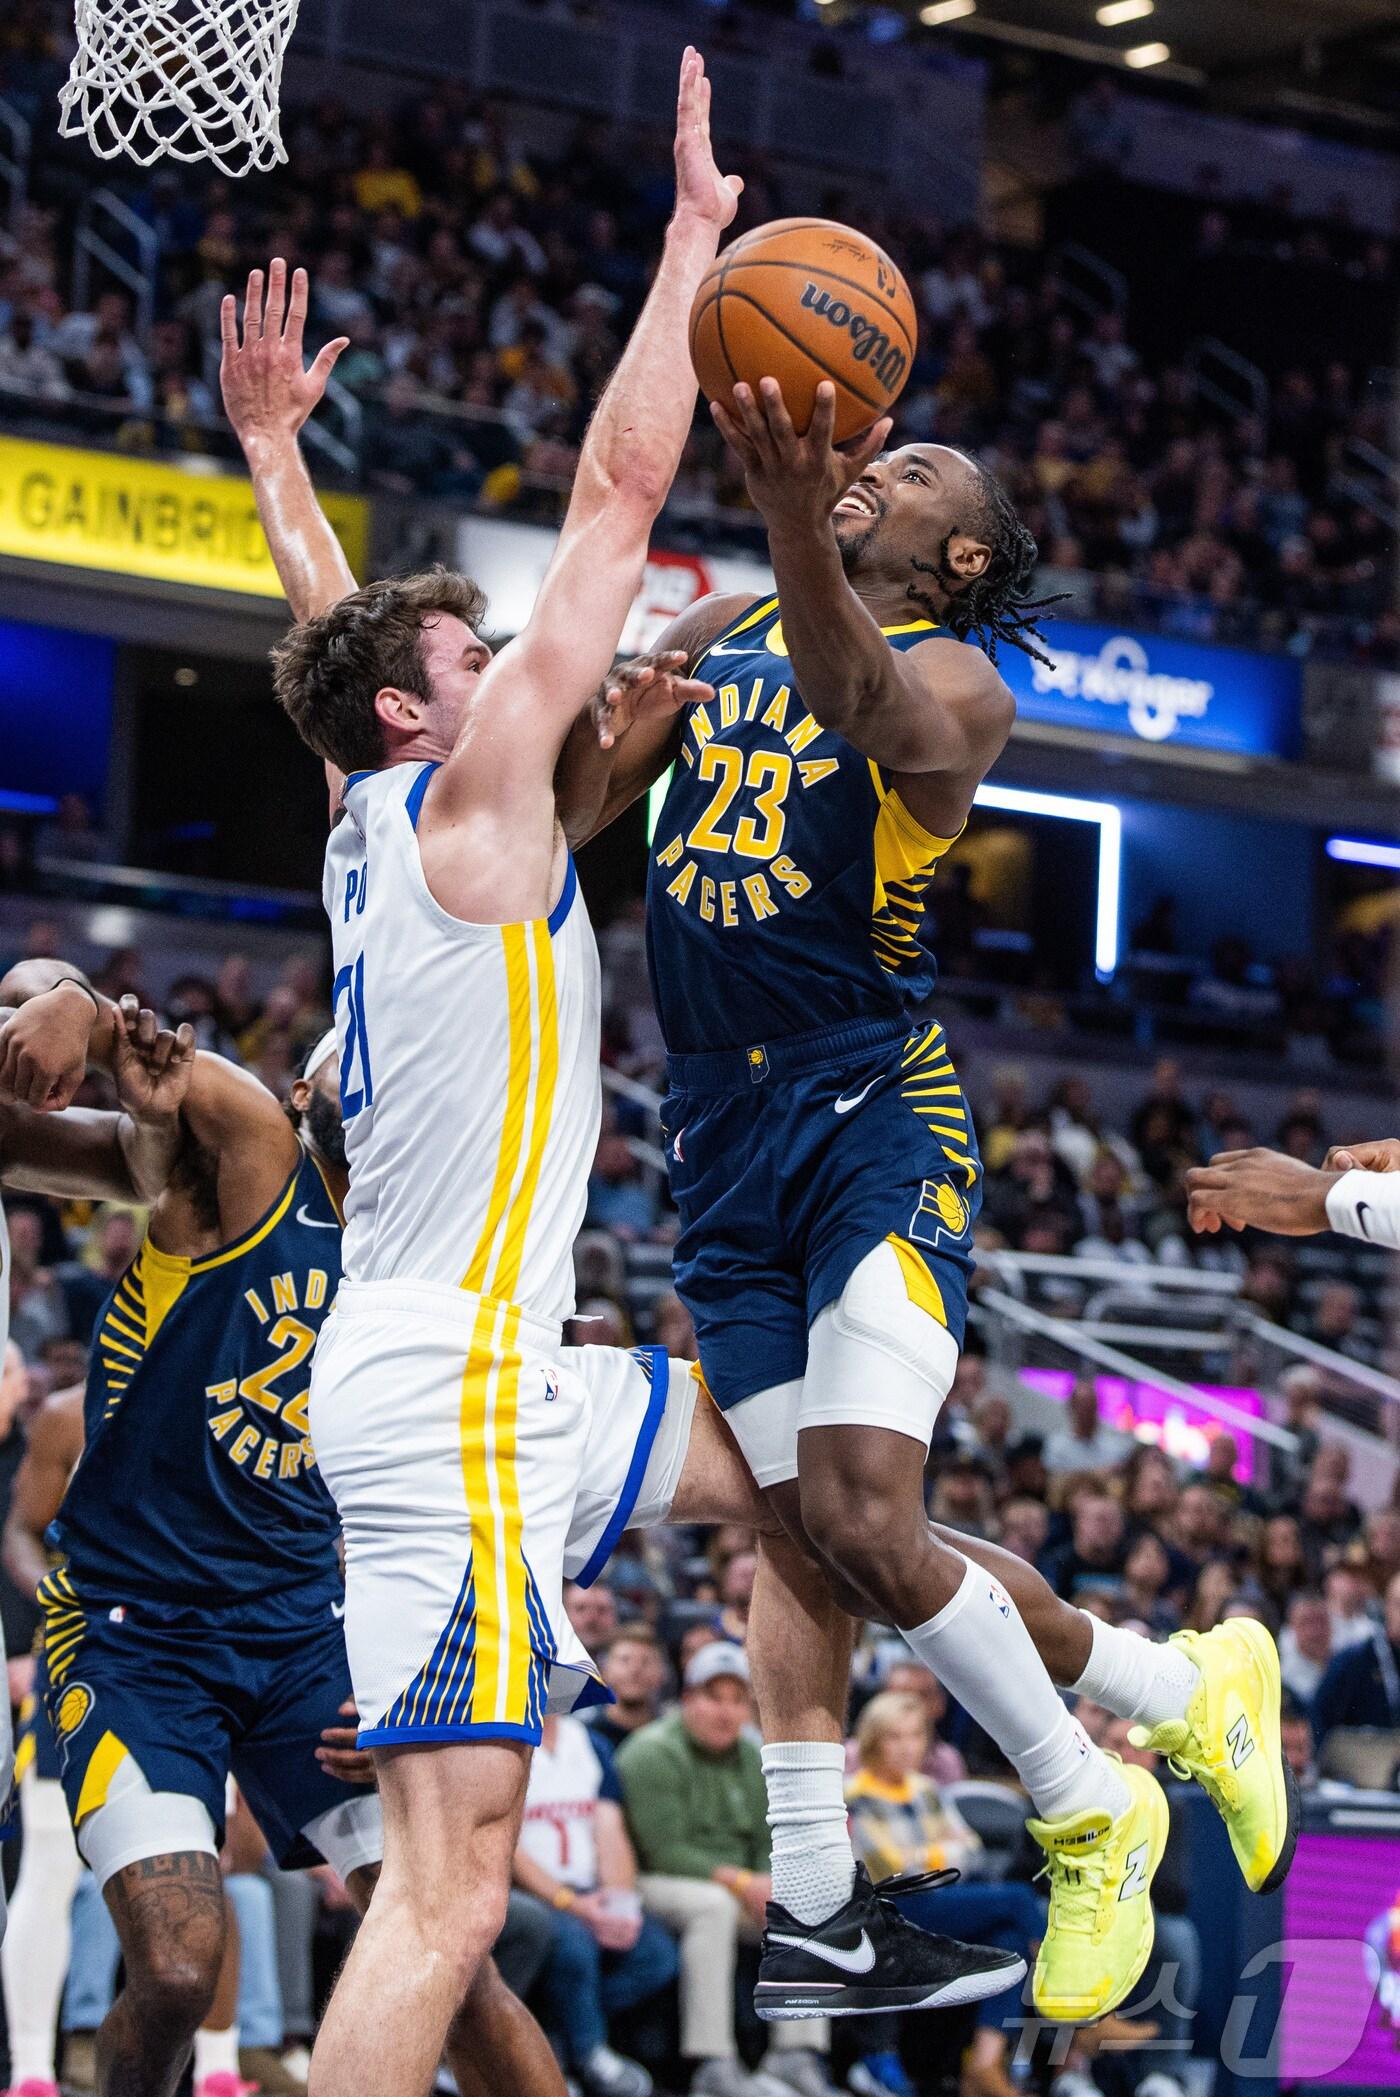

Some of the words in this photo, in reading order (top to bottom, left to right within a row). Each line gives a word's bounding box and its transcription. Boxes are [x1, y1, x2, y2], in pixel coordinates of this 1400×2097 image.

[801, 280, 907, 394] Wilson
[681, 678, 840, 789] INDIANA
[686, 743, 793, 860] 23
[656, 833, 812, 927] PACERS
[244, 1268, 337, 1325] IND
